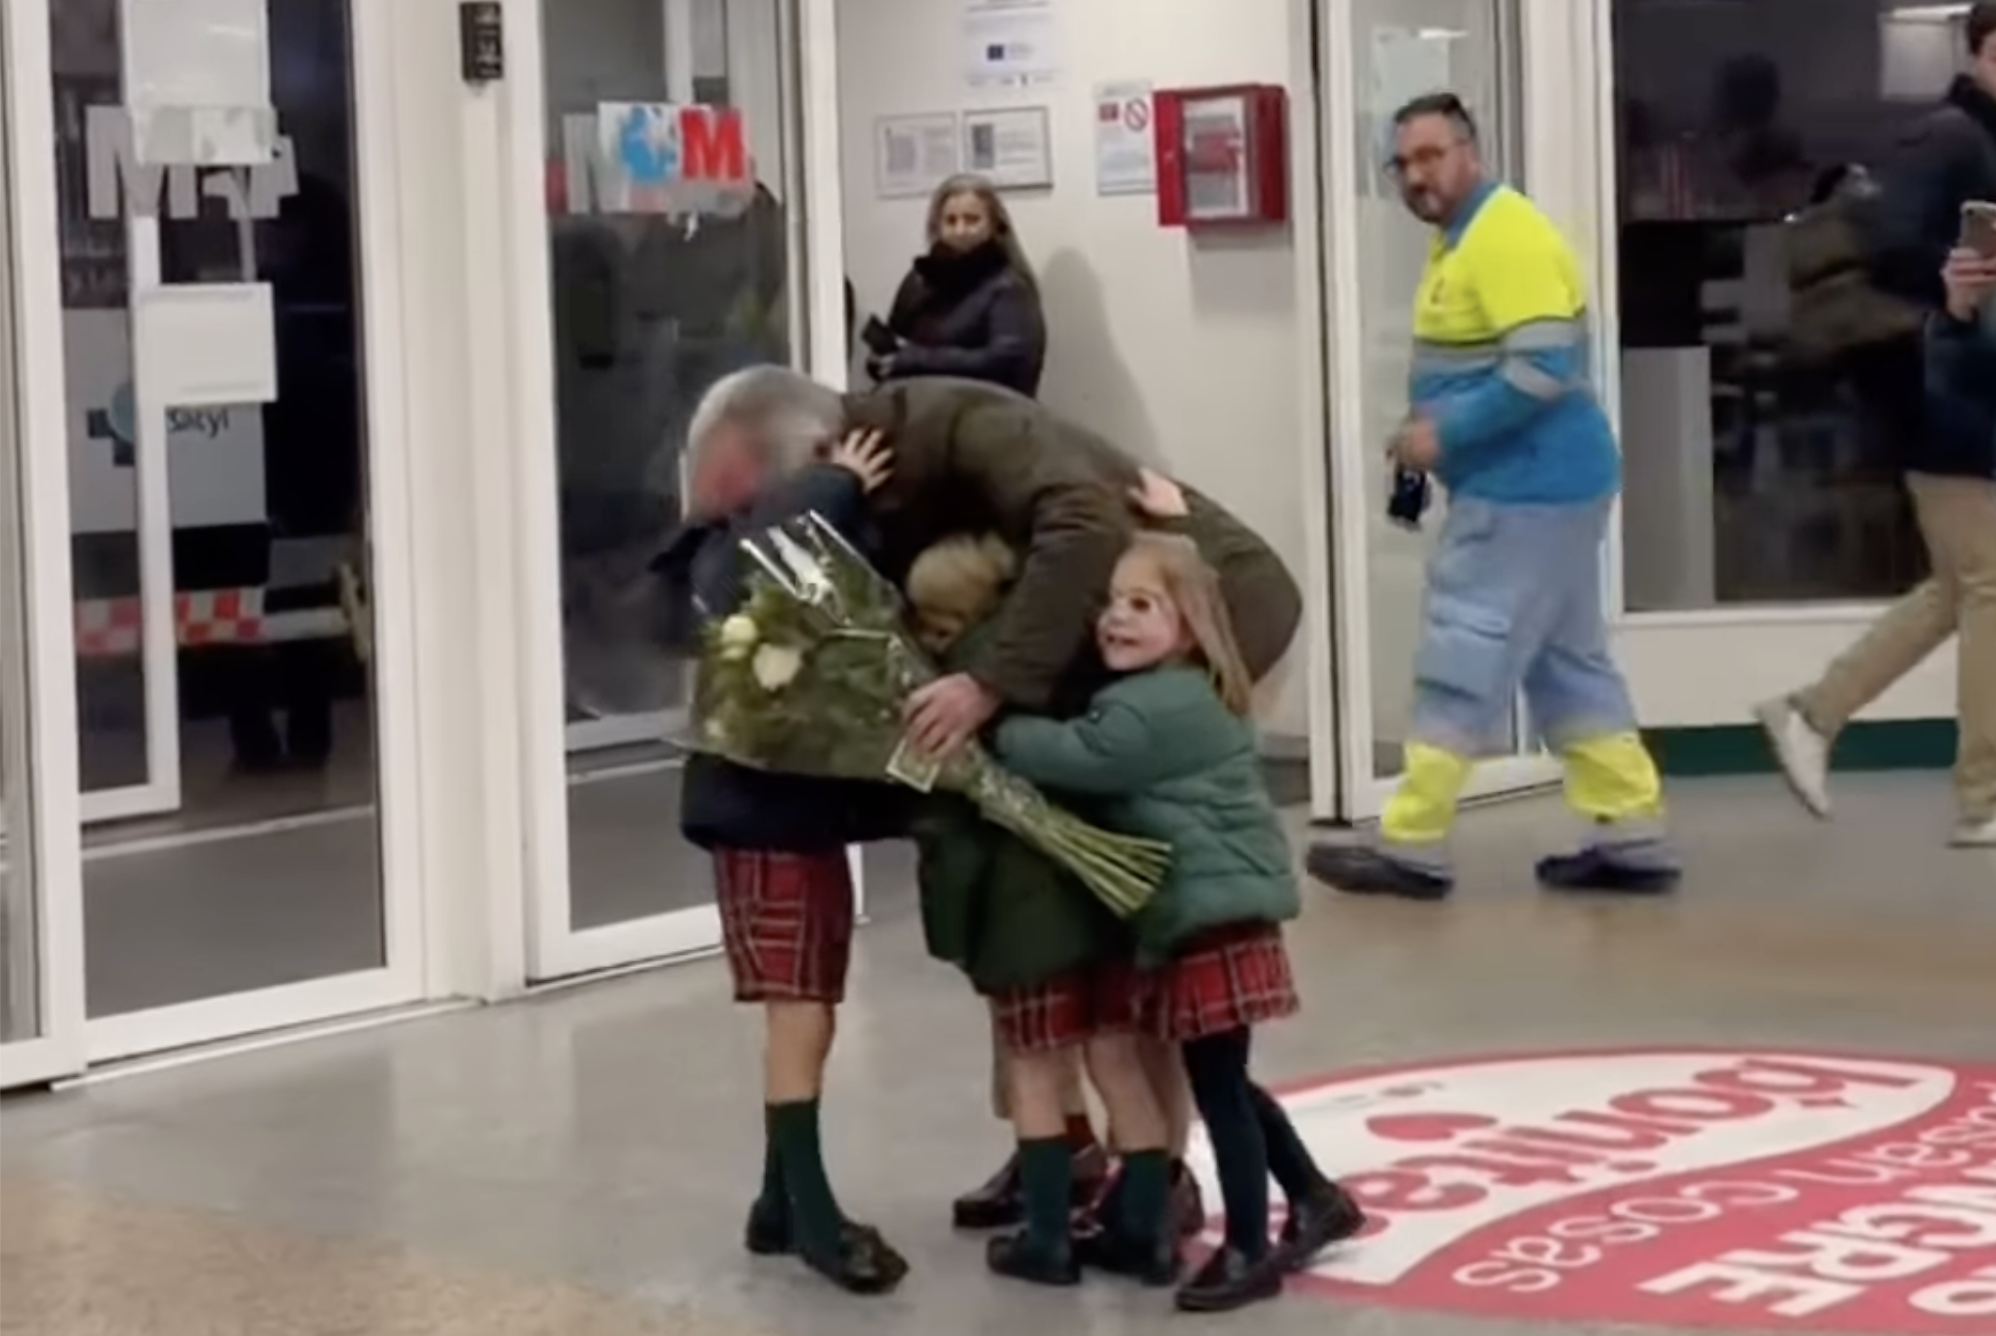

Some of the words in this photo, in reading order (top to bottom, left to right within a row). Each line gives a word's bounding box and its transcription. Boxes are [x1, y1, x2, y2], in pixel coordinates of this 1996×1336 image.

[680, 107, 745, 180] M
[1300, 1055, 1924, 1241] bonita
[1452, 1179, 1799, 1292] cosas
